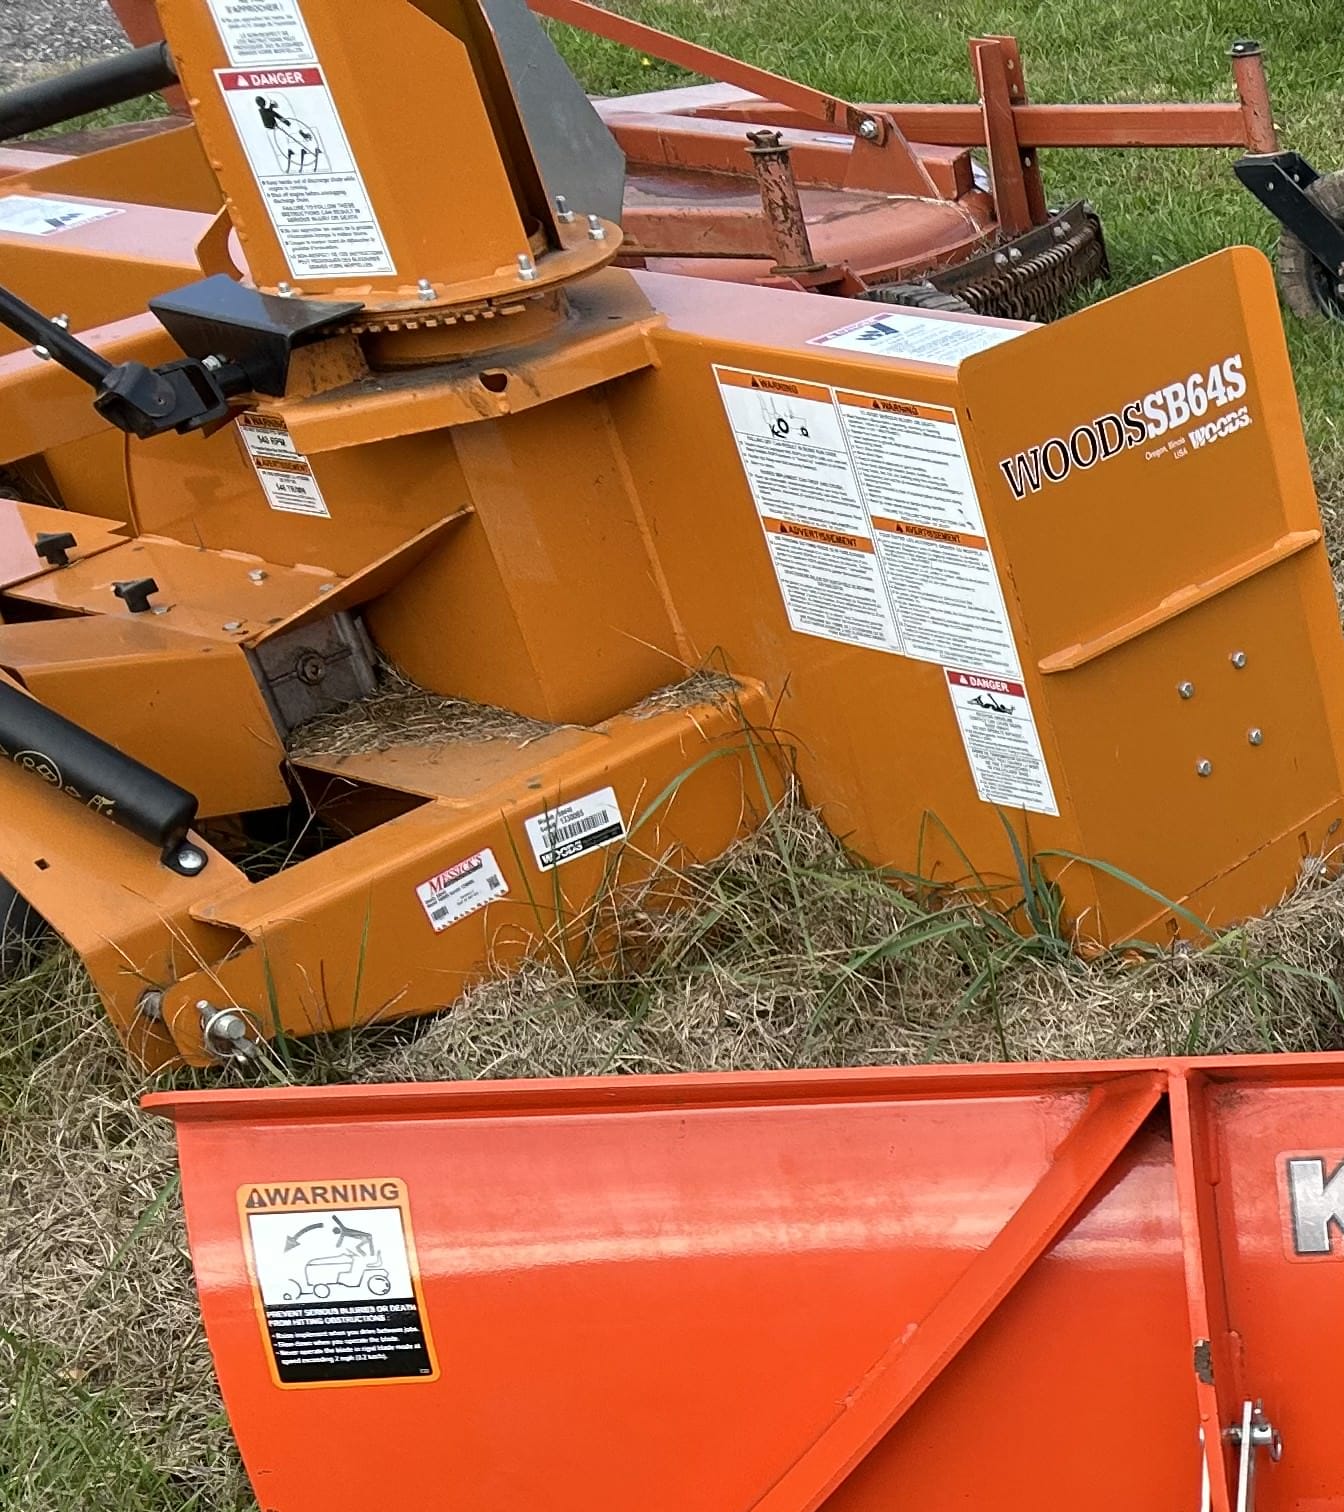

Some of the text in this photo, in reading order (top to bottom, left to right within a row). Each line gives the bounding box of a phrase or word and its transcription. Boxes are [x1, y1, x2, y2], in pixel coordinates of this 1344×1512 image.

[249, 71, 304, 87] DANGER
[1000, 400, 1148, 501] WOODS
[1143, 354, 1247, 439] SB64S
[970, 676, 1009, 692] DANGER
[264, 1183, 399, 1206] WARNING
